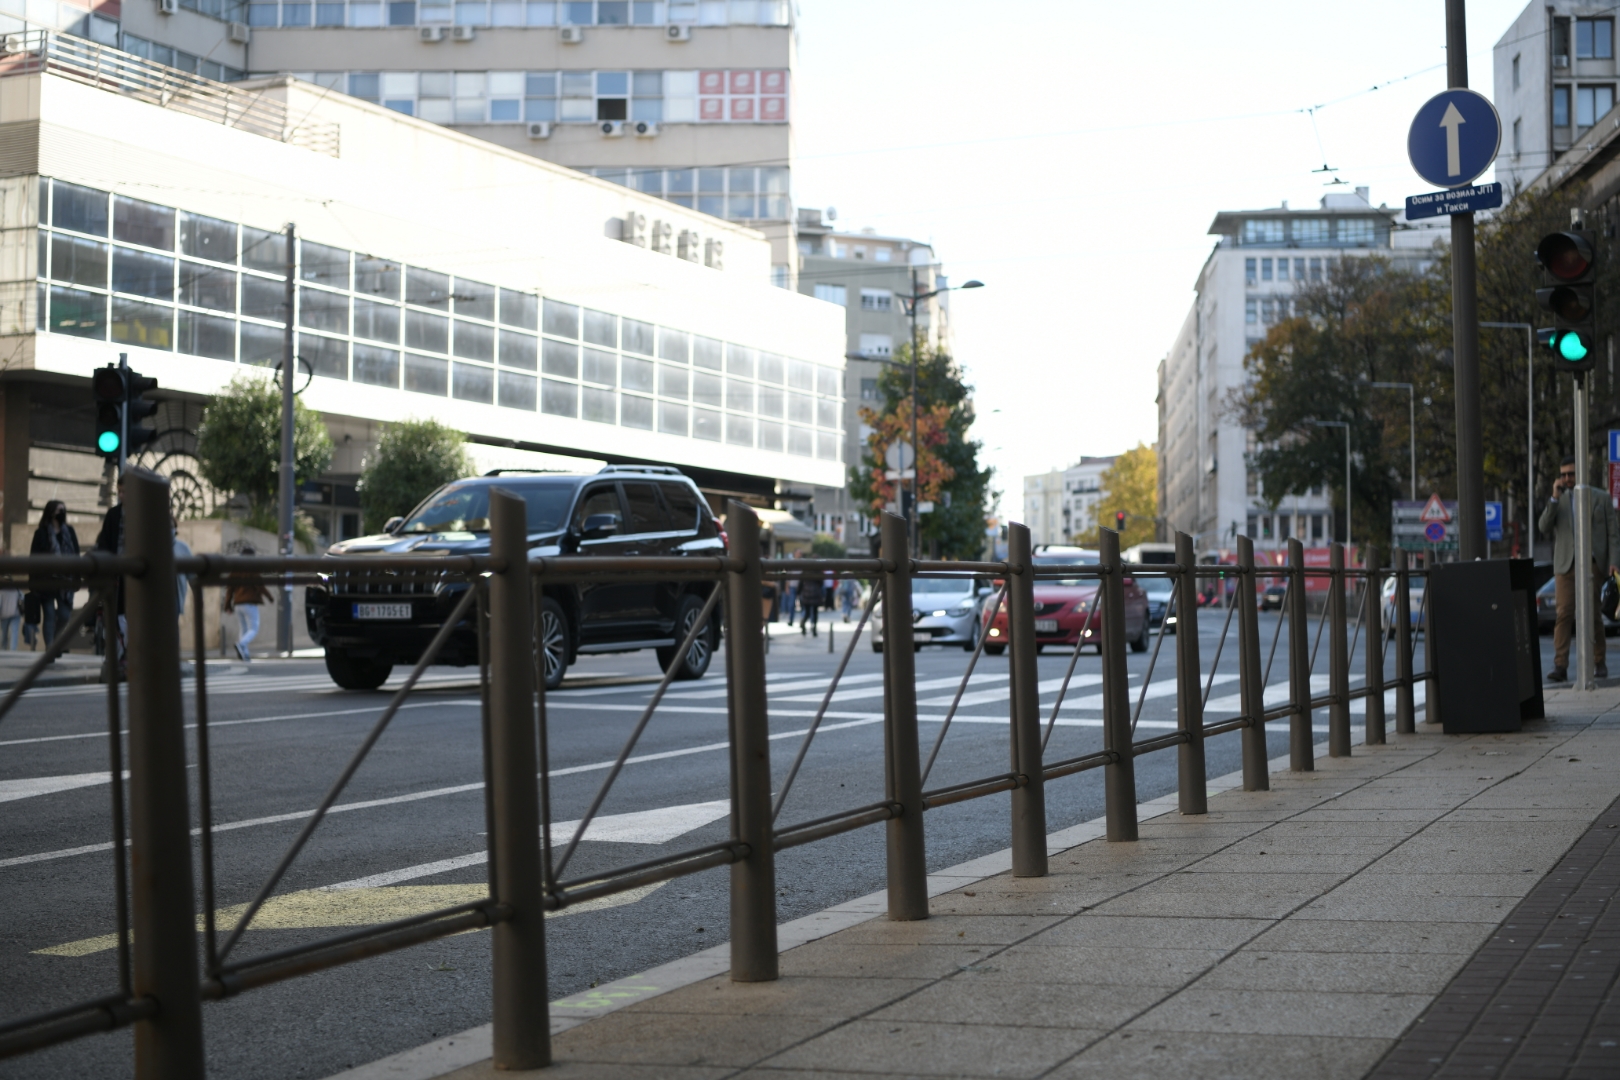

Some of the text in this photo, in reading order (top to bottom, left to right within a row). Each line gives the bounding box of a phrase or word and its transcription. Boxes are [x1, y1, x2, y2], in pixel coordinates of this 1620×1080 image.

[1412, 196, 1433, 205] Осим
[1434, 193, 1445, 202] за
[1446, 188, 1475, 200] возила
[1436, 202, 1469, 214] и Такси
